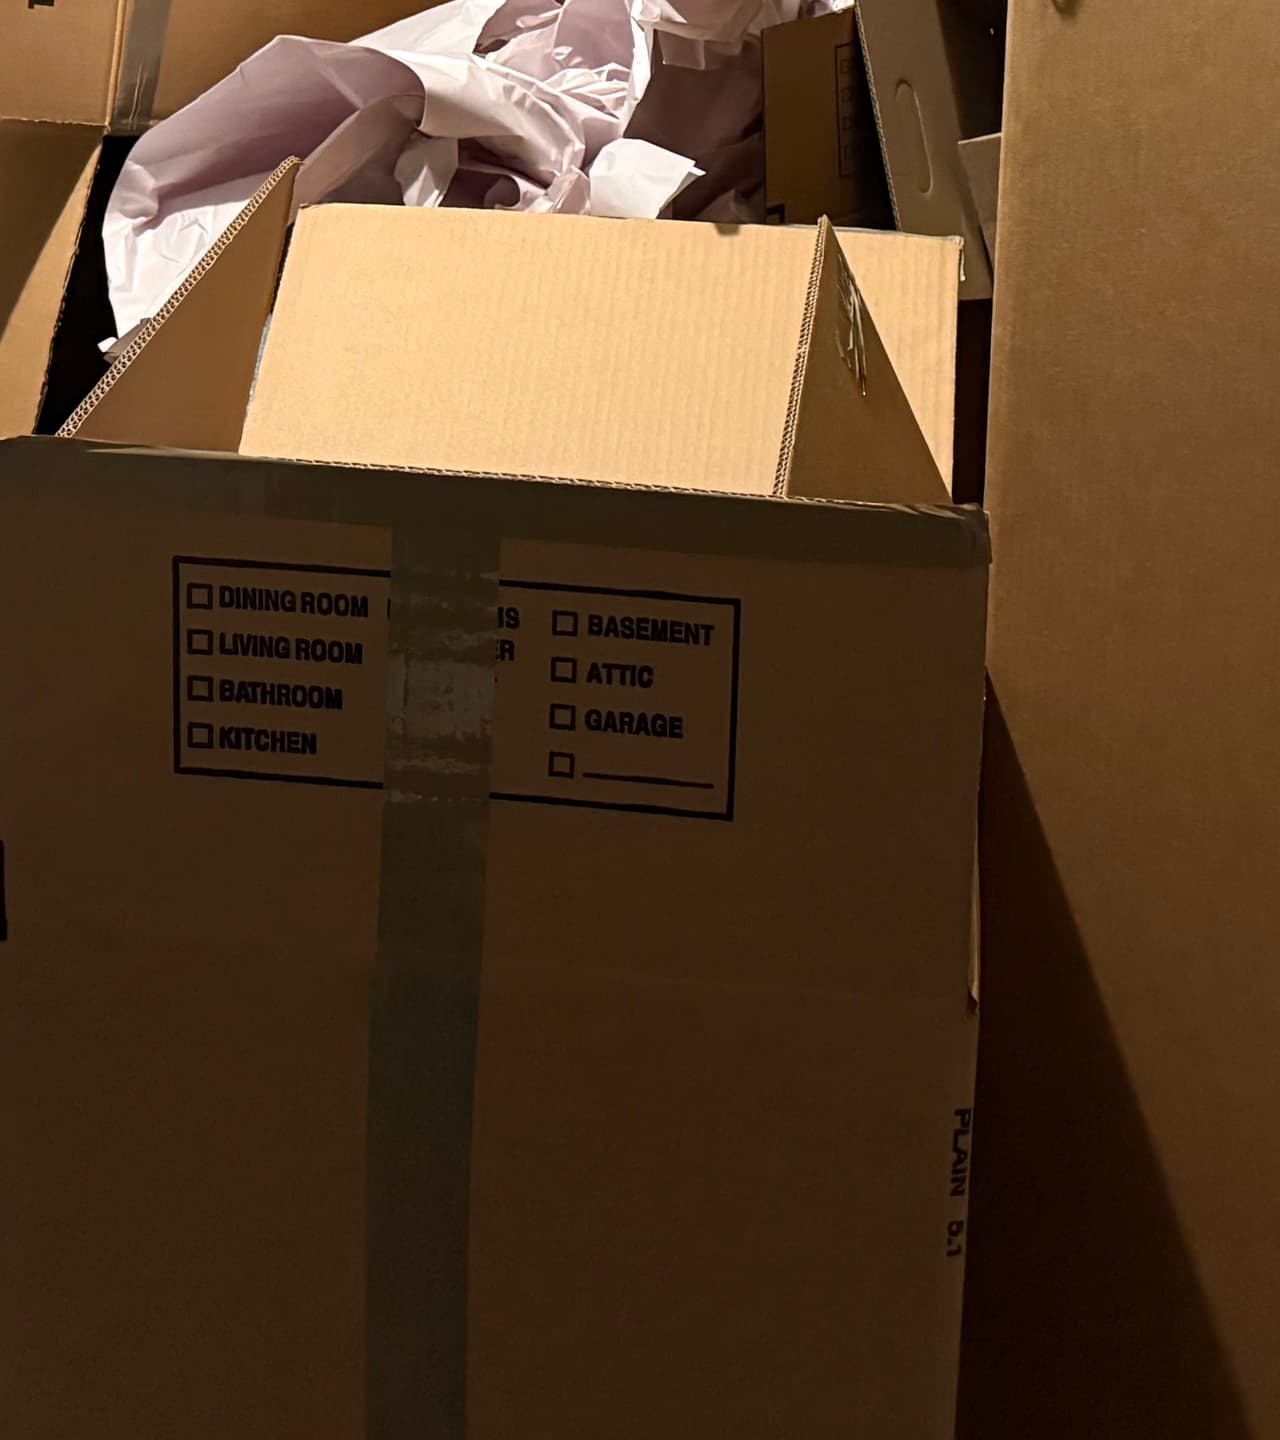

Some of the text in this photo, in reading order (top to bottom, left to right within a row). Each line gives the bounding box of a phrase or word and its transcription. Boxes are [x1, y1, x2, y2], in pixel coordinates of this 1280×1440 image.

[219, 585, 368, 617] DINING ROOM
[587, 615, 715, 646] BASEMENT
[219, 631, 363, 664] LIVING ROOM
[585, 661, 654, 688] ATTIC
[219, 680, 343, 710] BATHROOM
[583, 708, 683, 739] GARAGE
[219, 725, 318, 755] KITCHEN
[946, 1107, 971, 1257] PLAIN 5.1
